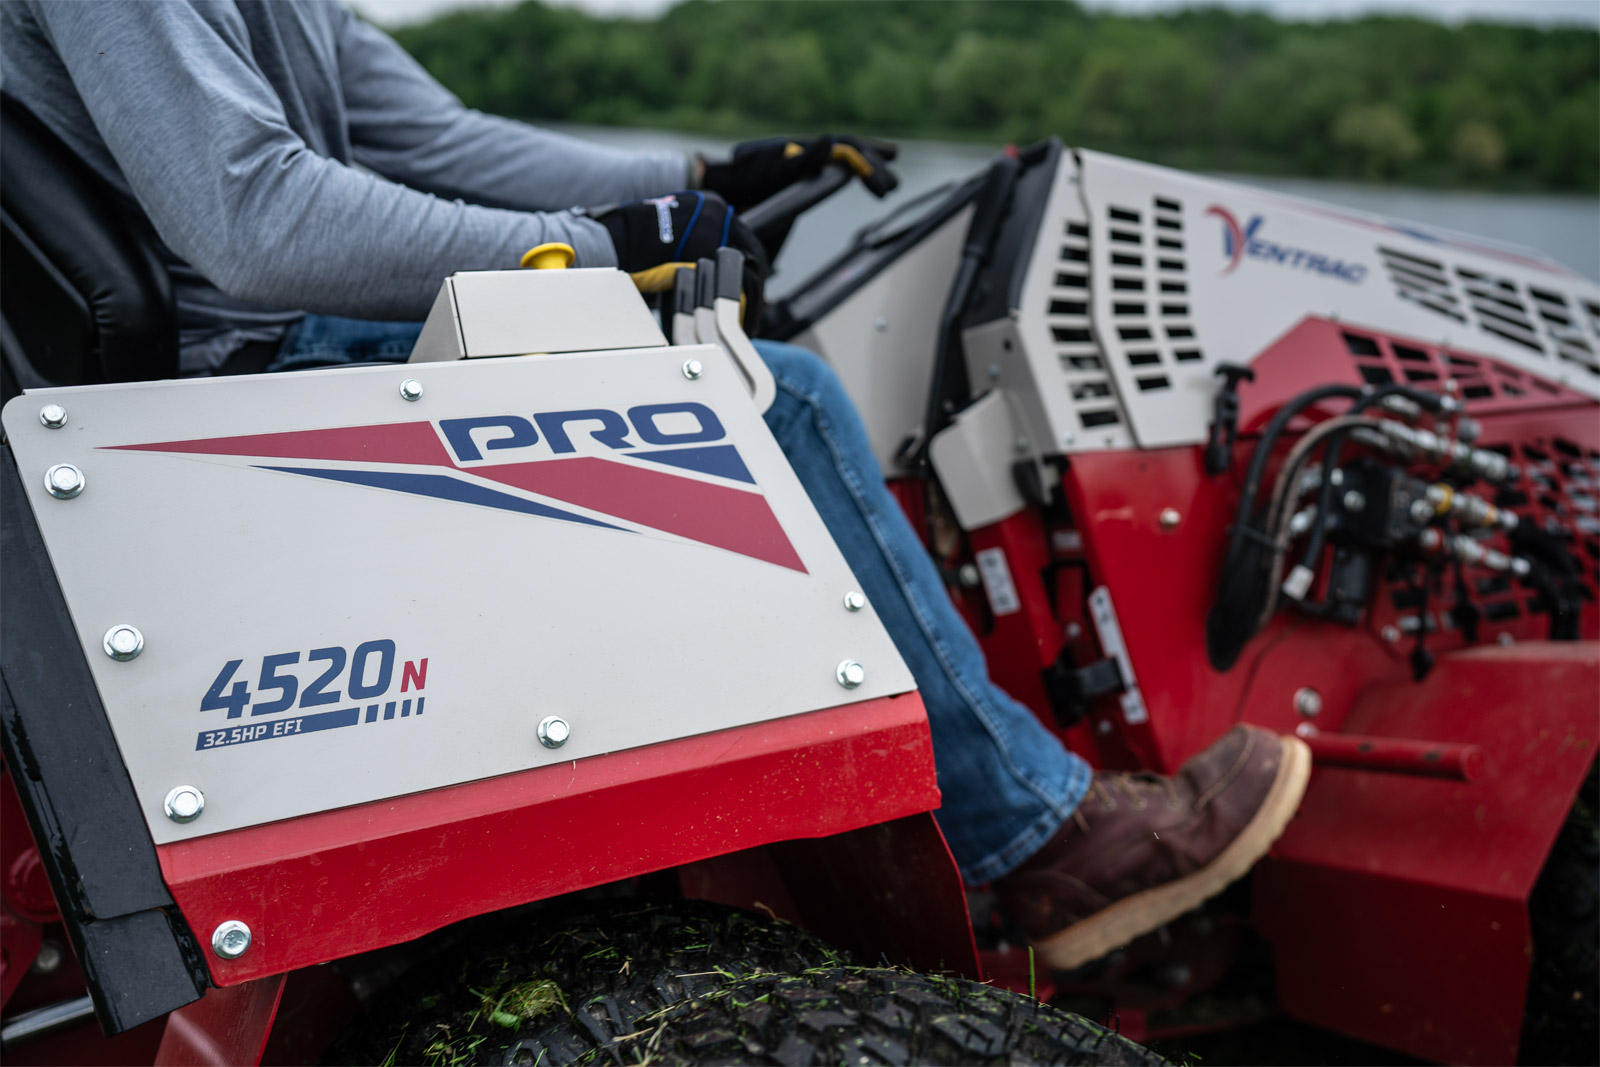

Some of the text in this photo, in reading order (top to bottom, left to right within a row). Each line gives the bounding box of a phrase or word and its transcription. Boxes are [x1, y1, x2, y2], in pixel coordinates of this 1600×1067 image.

[1213, 208, 1367, 284] VENTRAC
[438, 402, 726, 461] PRO
[203, 719, 303, 747] 32.5HP EFI
